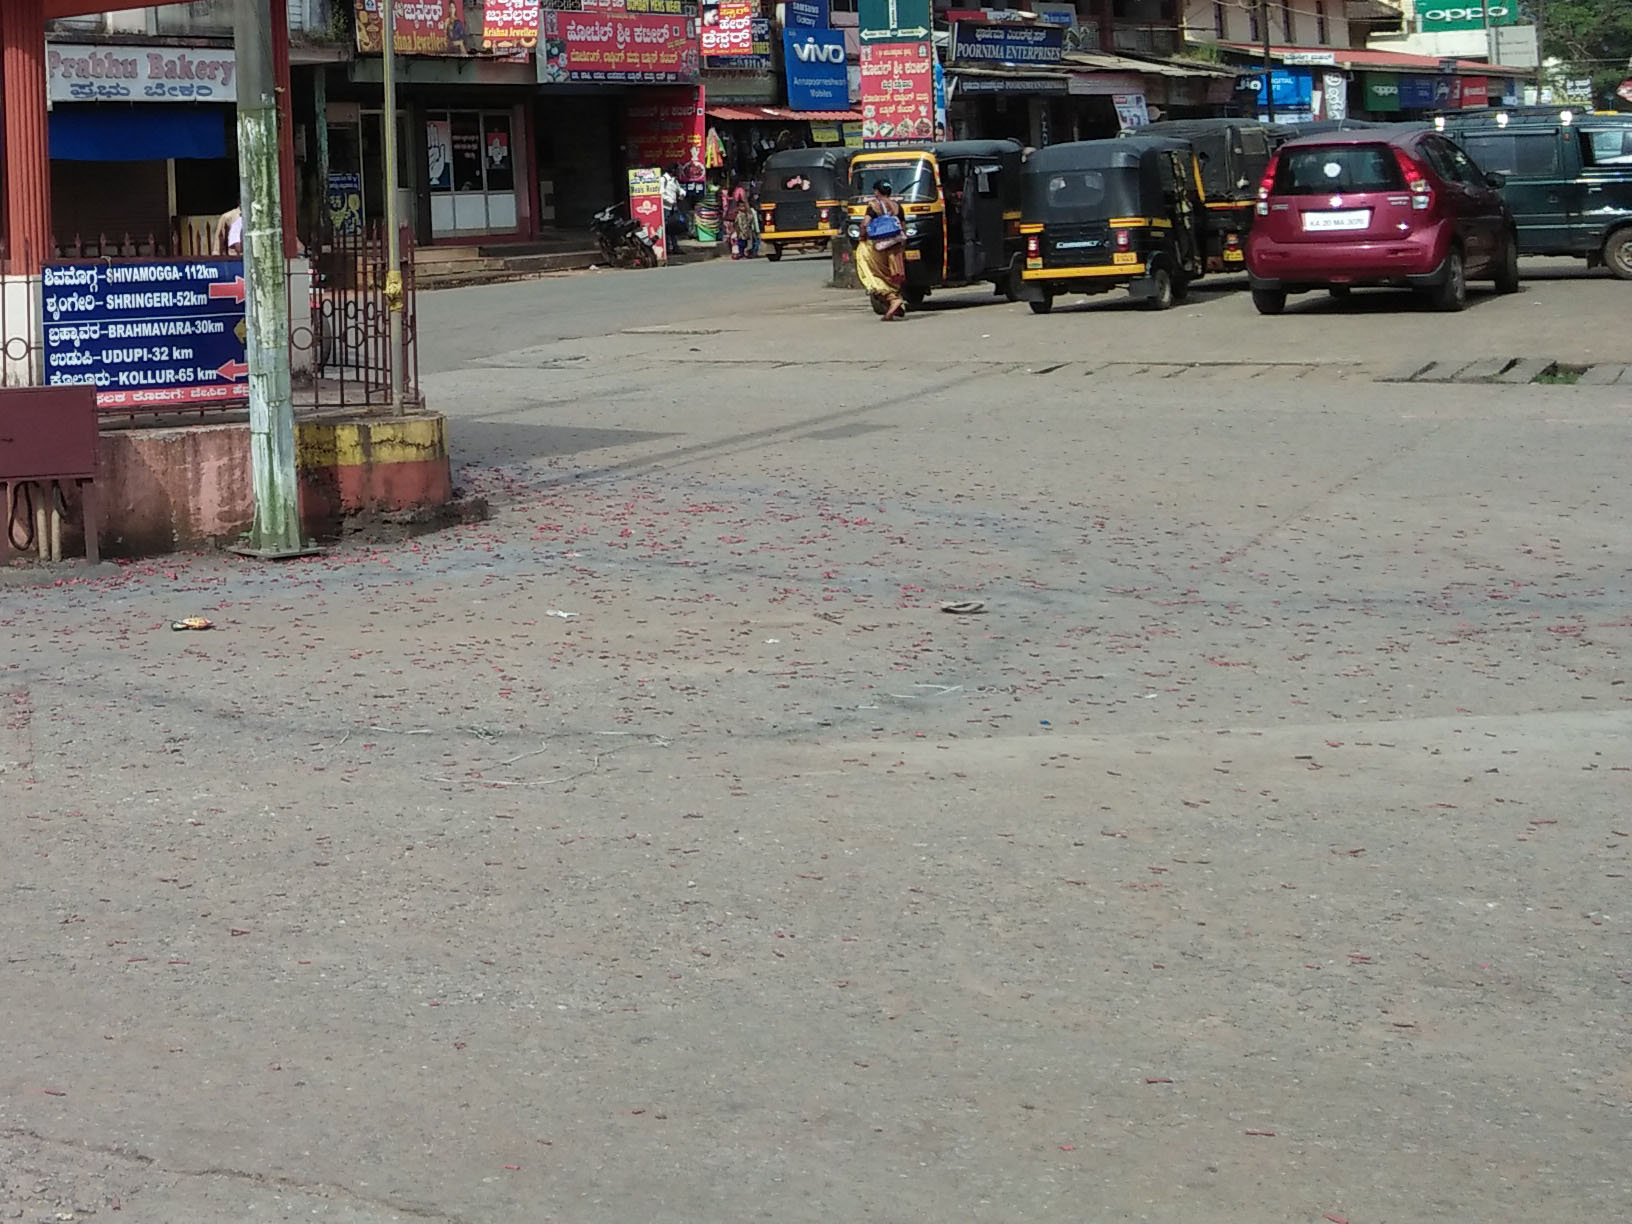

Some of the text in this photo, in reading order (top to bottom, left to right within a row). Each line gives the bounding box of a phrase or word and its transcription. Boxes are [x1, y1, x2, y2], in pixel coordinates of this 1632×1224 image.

[956, 43, 1061, 62] POORNIMA ENTERPRISES
[48, 50, 236, 86] Prabhu Bakery
[184, 265, 218, 280] 112km
[173, 347, 193, 361] km
[197, 367, 217, 381] km
